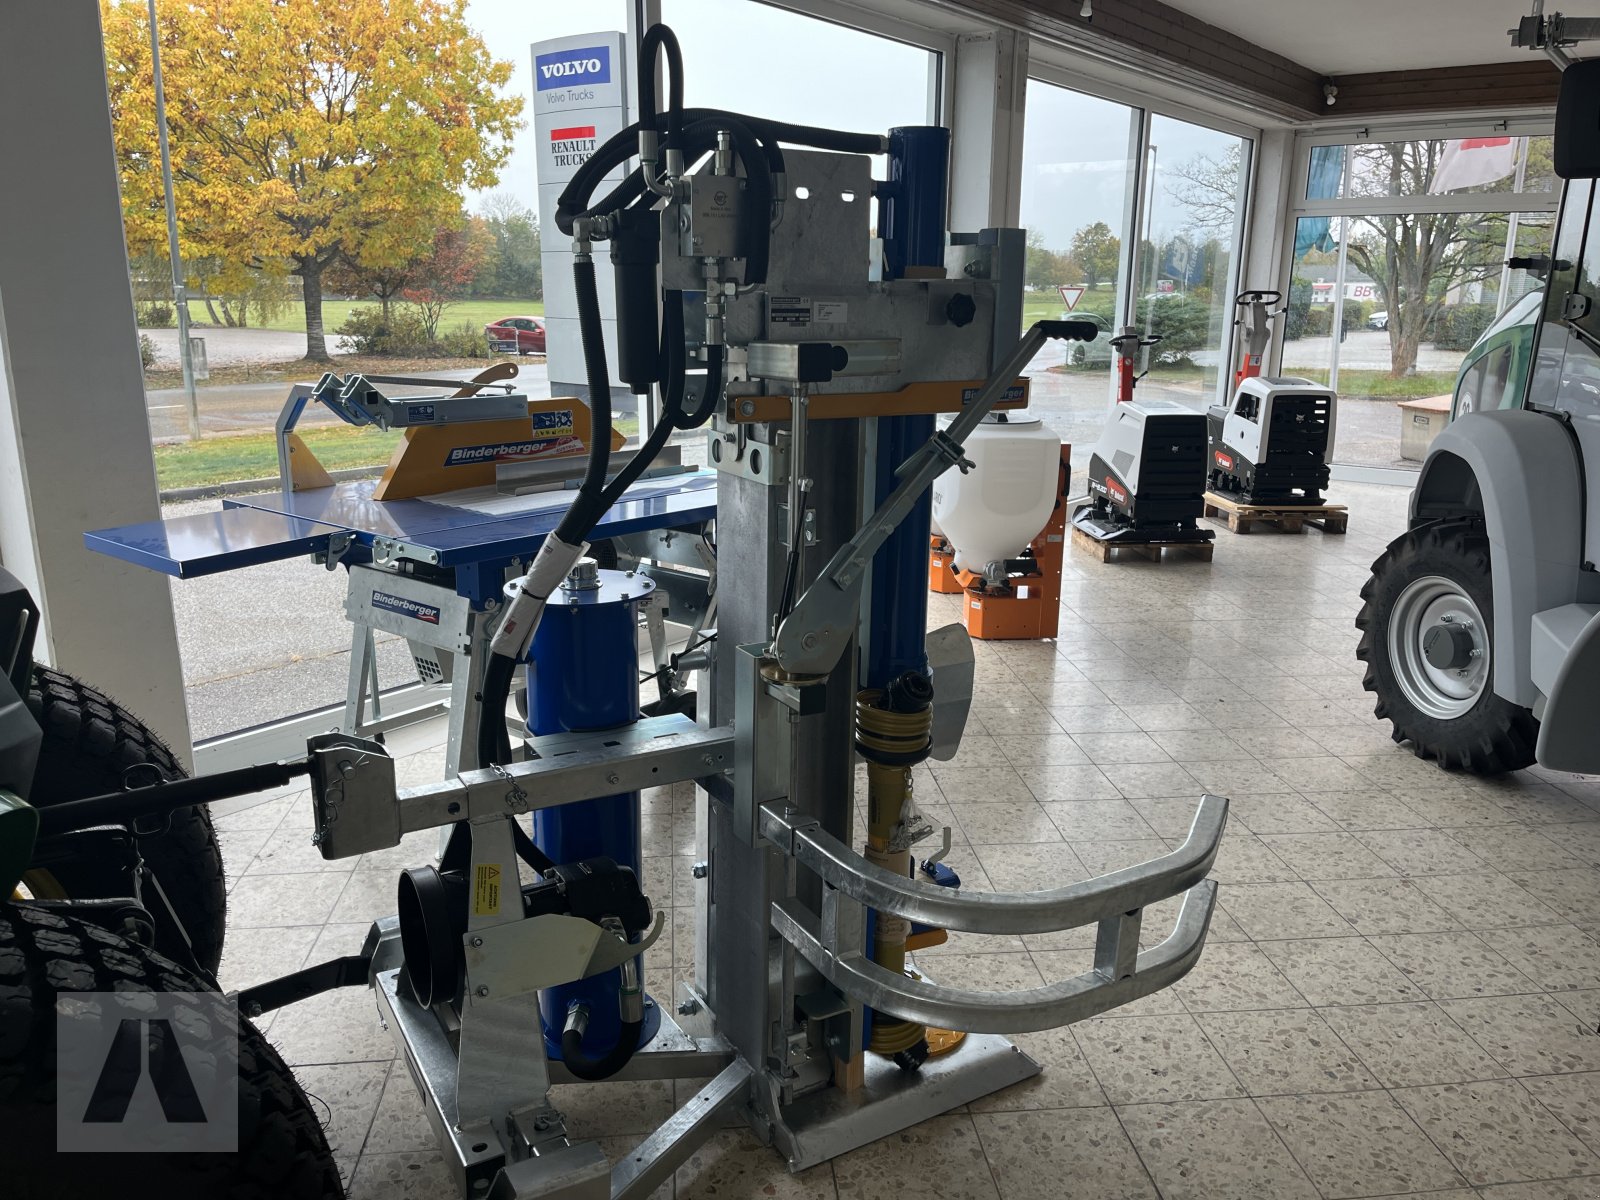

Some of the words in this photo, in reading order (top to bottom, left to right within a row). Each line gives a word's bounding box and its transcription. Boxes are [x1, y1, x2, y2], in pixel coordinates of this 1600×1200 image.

[541, 58, 601, 78] VOLVO
[546, 93, 565, 104] Volvo
[567, 89, 594, 101] Trucks
[551, 139, 597, 154] RENAULT
[451, 442, 547, 460] Binderberger
[373, 592, 437, 617] Binderberger
